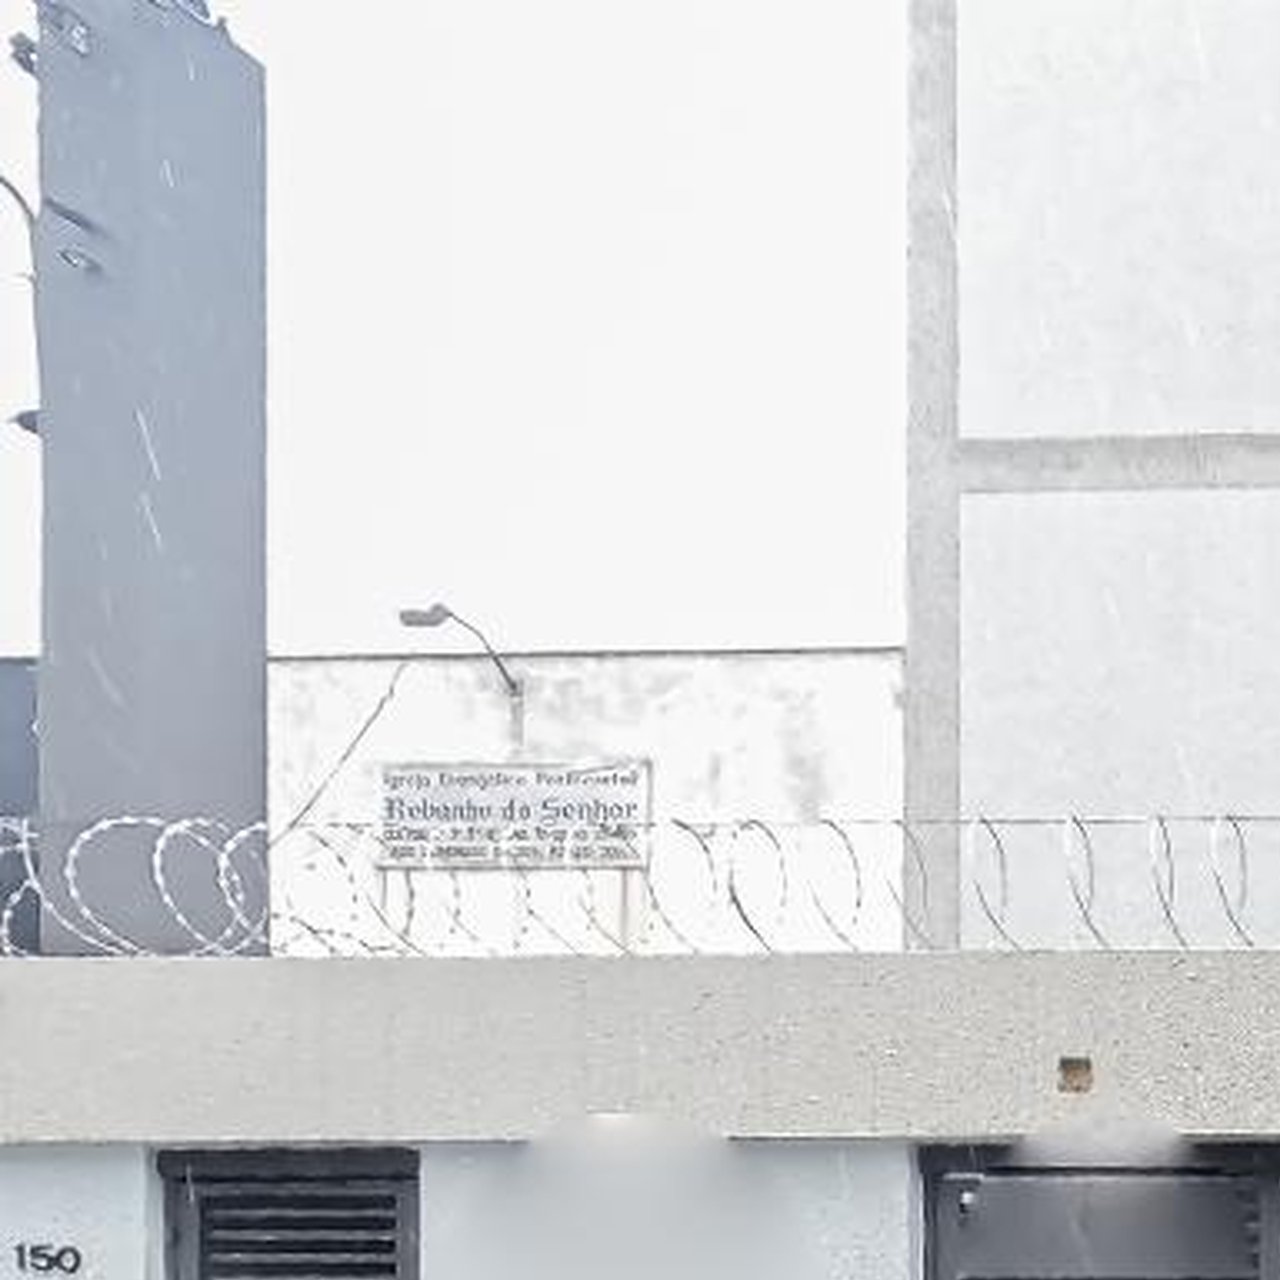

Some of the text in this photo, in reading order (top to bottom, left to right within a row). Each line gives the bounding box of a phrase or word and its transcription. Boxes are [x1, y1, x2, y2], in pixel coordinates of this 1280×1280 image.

[382, 796, 639, 822] Rebanho do Senhor
[14, 1243, 82, 1274] 150
